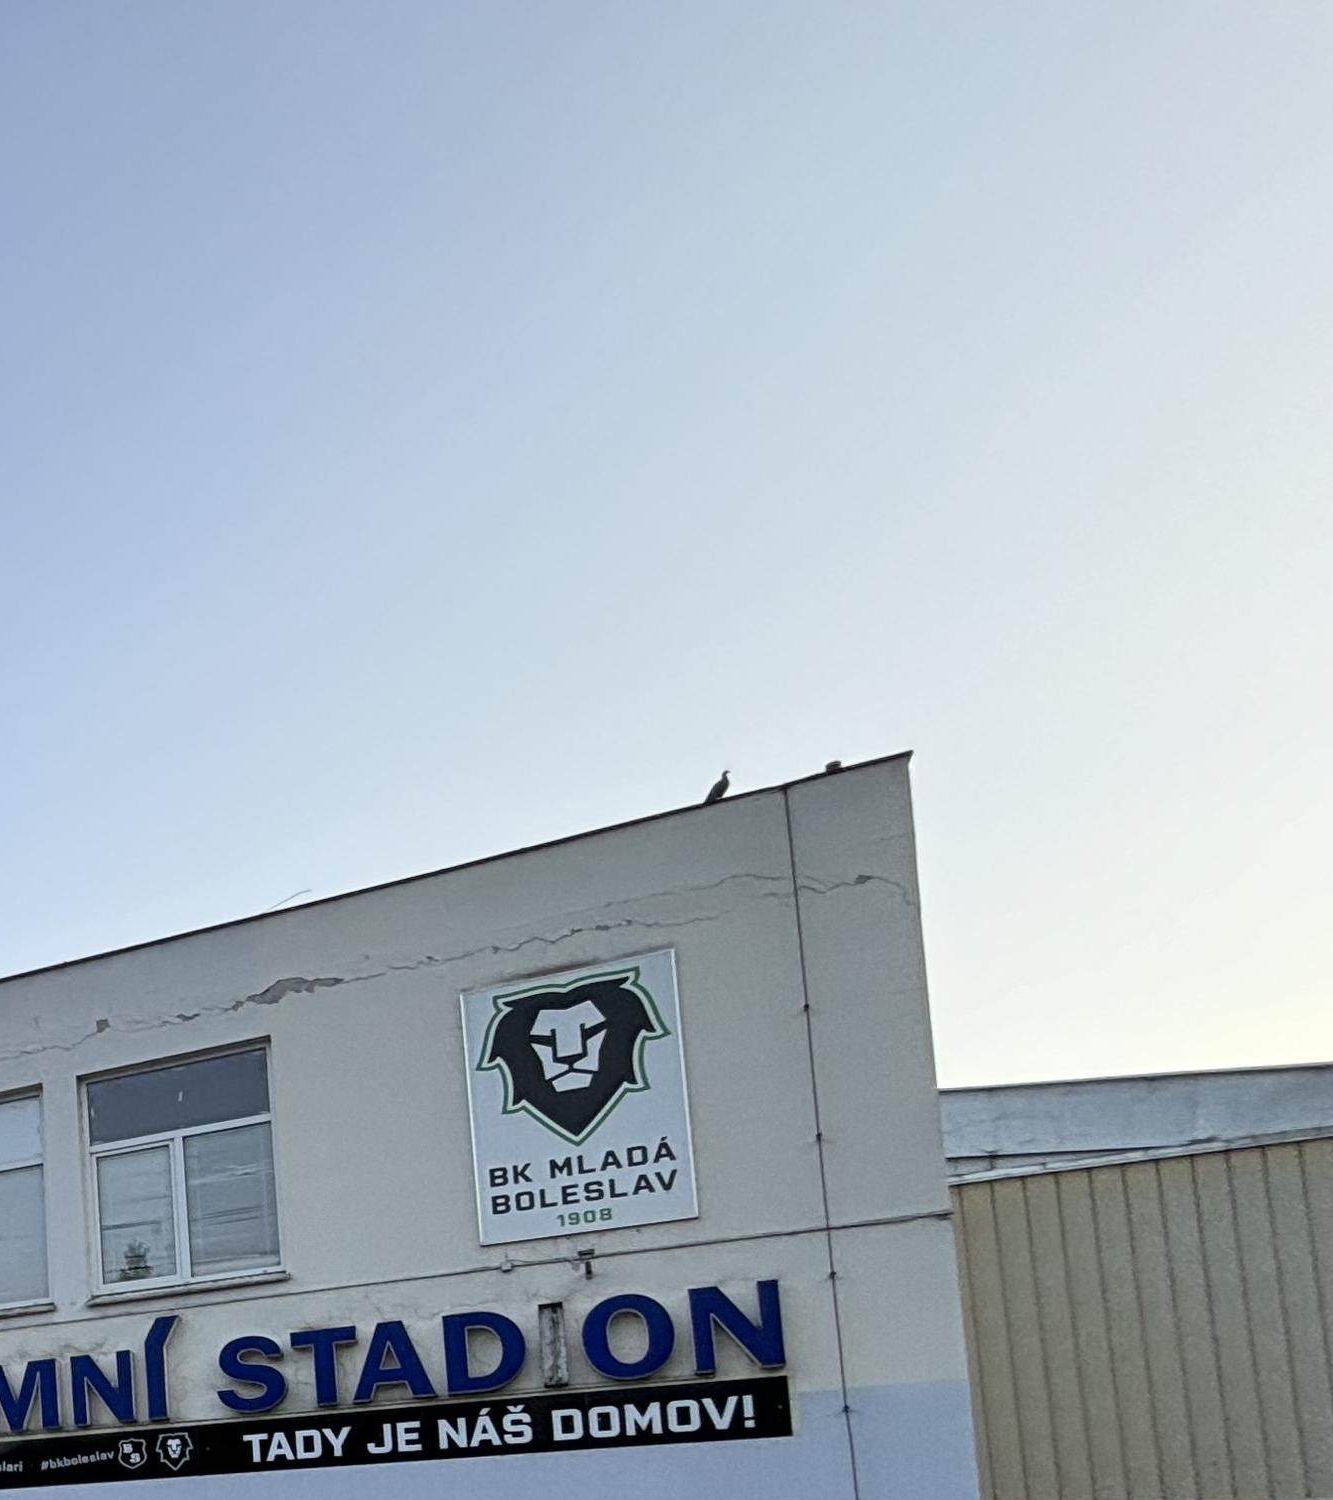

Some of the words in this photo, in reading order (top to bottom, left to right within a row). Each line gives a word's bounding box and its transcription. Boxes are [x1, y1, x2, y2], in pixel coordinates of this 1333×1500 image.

[488, 1161, 533, 1188] BK
[549, 1136, 678, 1179] MLADÁ
[490, 1169, 679, 1216] BOLESLAV
[556, 1207, 613, 1228] 1908
[217, 1279, 787, 1414] STADION
[243, 1425, 352, 1463] TADY
[366, 1420, 423, 1455] JE
[438, 1405, 533, 1451] NÁŠ
[551, 1394, 757, 1442] DOMOV!
